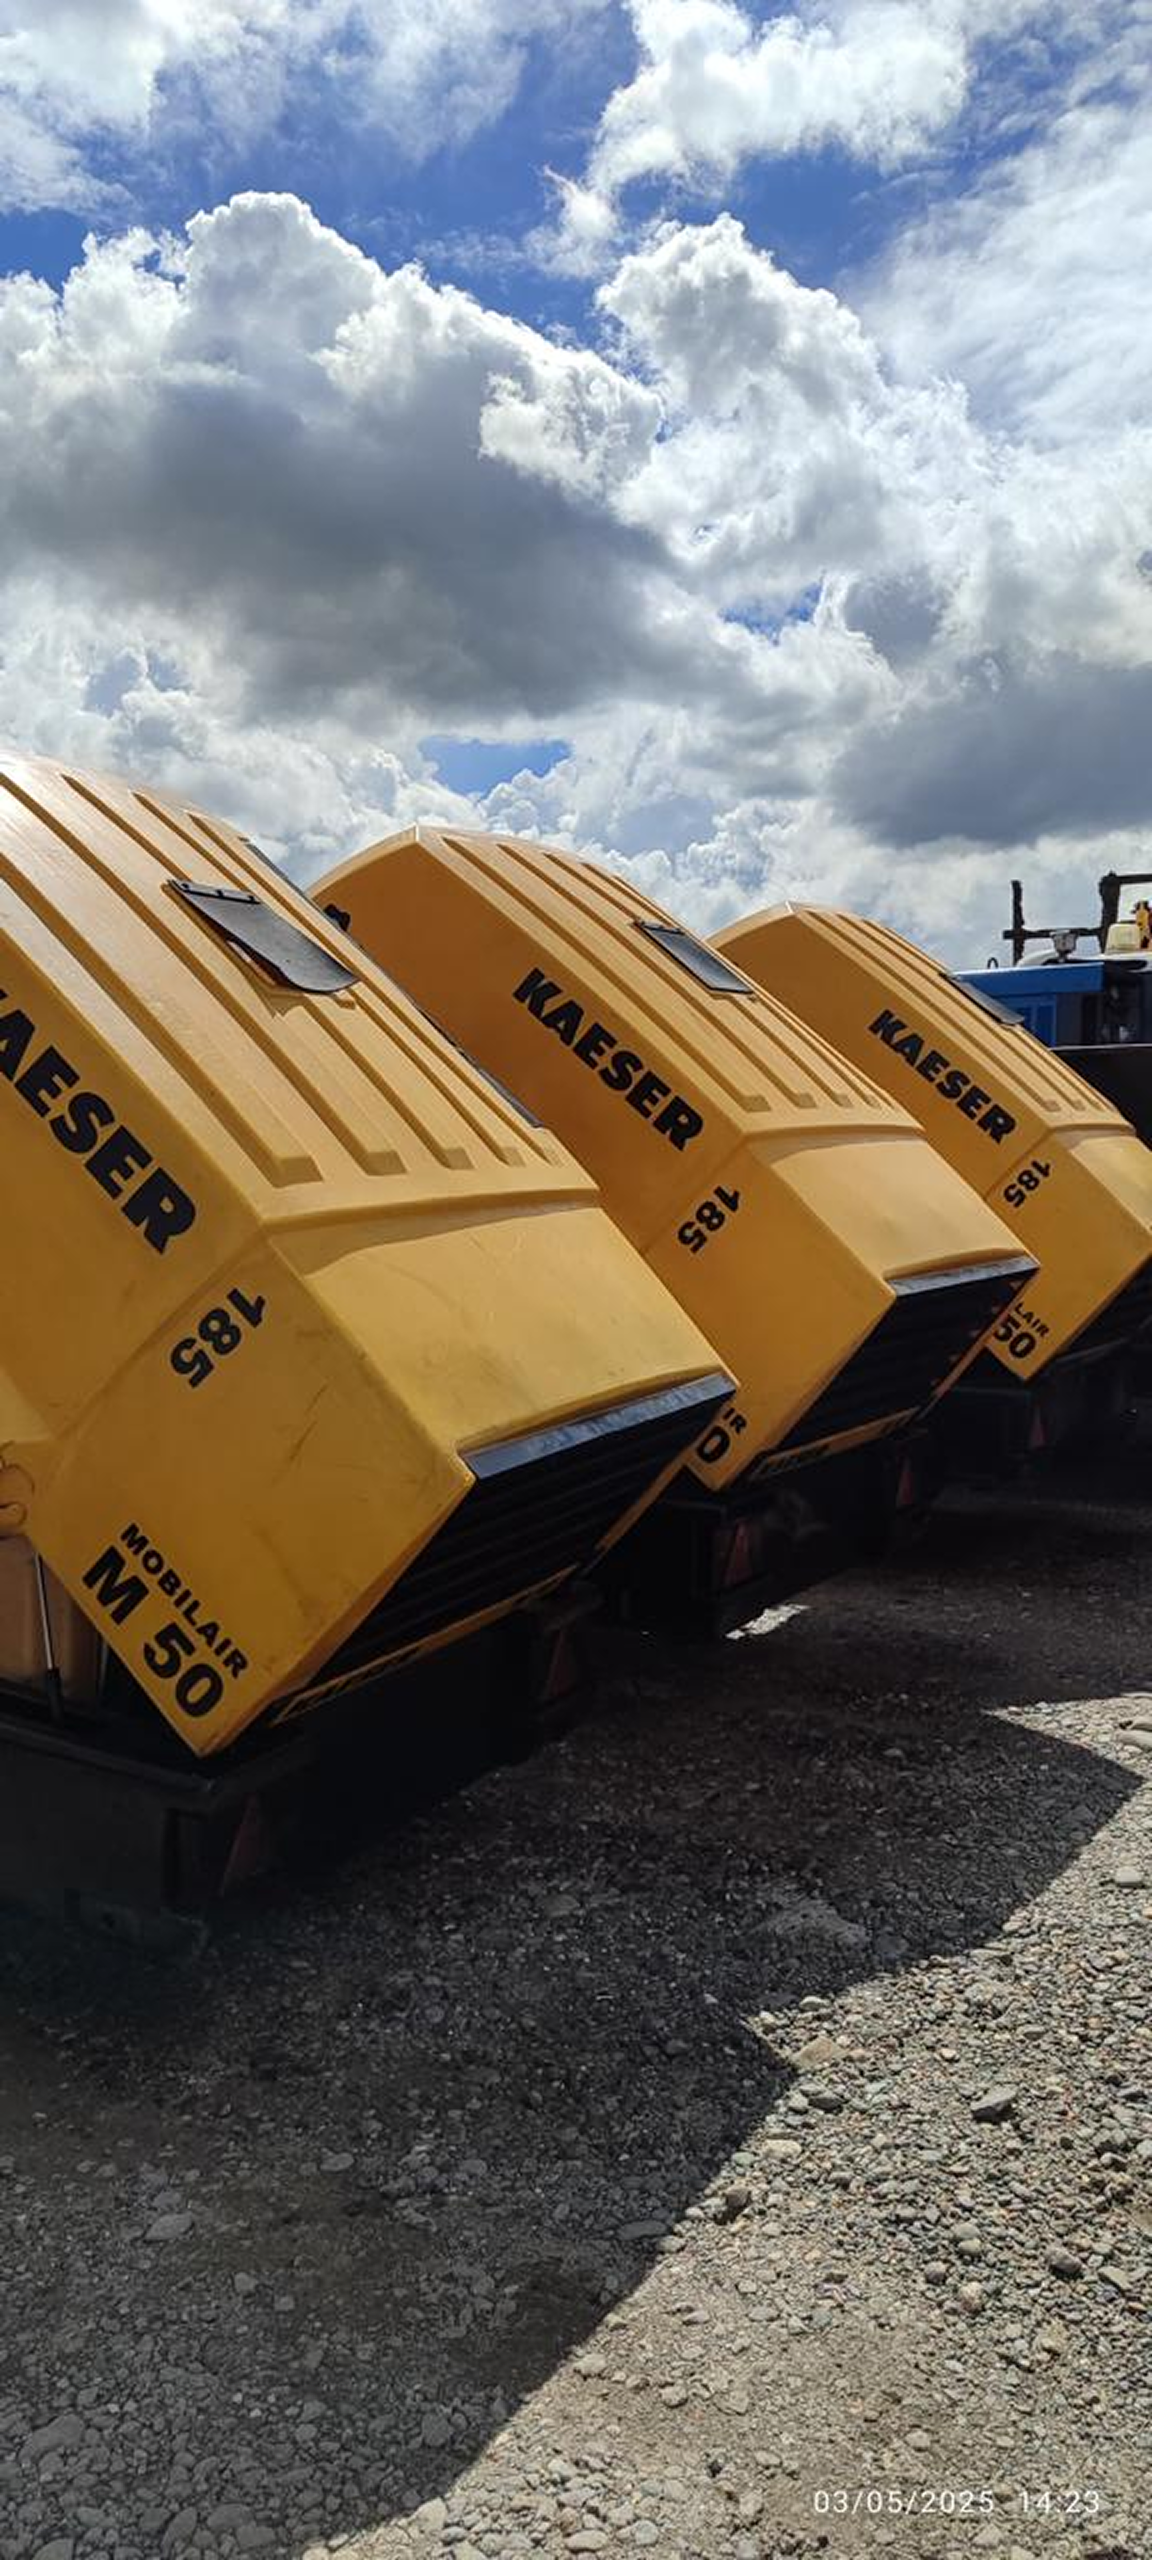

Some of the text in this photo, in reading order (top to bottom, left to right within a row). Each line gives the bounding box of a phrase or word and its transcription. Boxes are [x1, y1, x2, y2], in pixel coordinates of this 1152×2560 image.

[0, 989, 197, 1256] AESER
[513, 967, 705, 1152] KAESER
[867, 1009, 1018, 1145] KAESER
[677, 1186, 742, 1254] 185
[1003, 1159, 1052, 1209] 185
[170, 1287, 267, 1389] 185
[697, 1427, 731, 1463] 0
[82, 1545, 225, 1718] M 50
[119, 1523, 249, 1679] MOBILAIR
